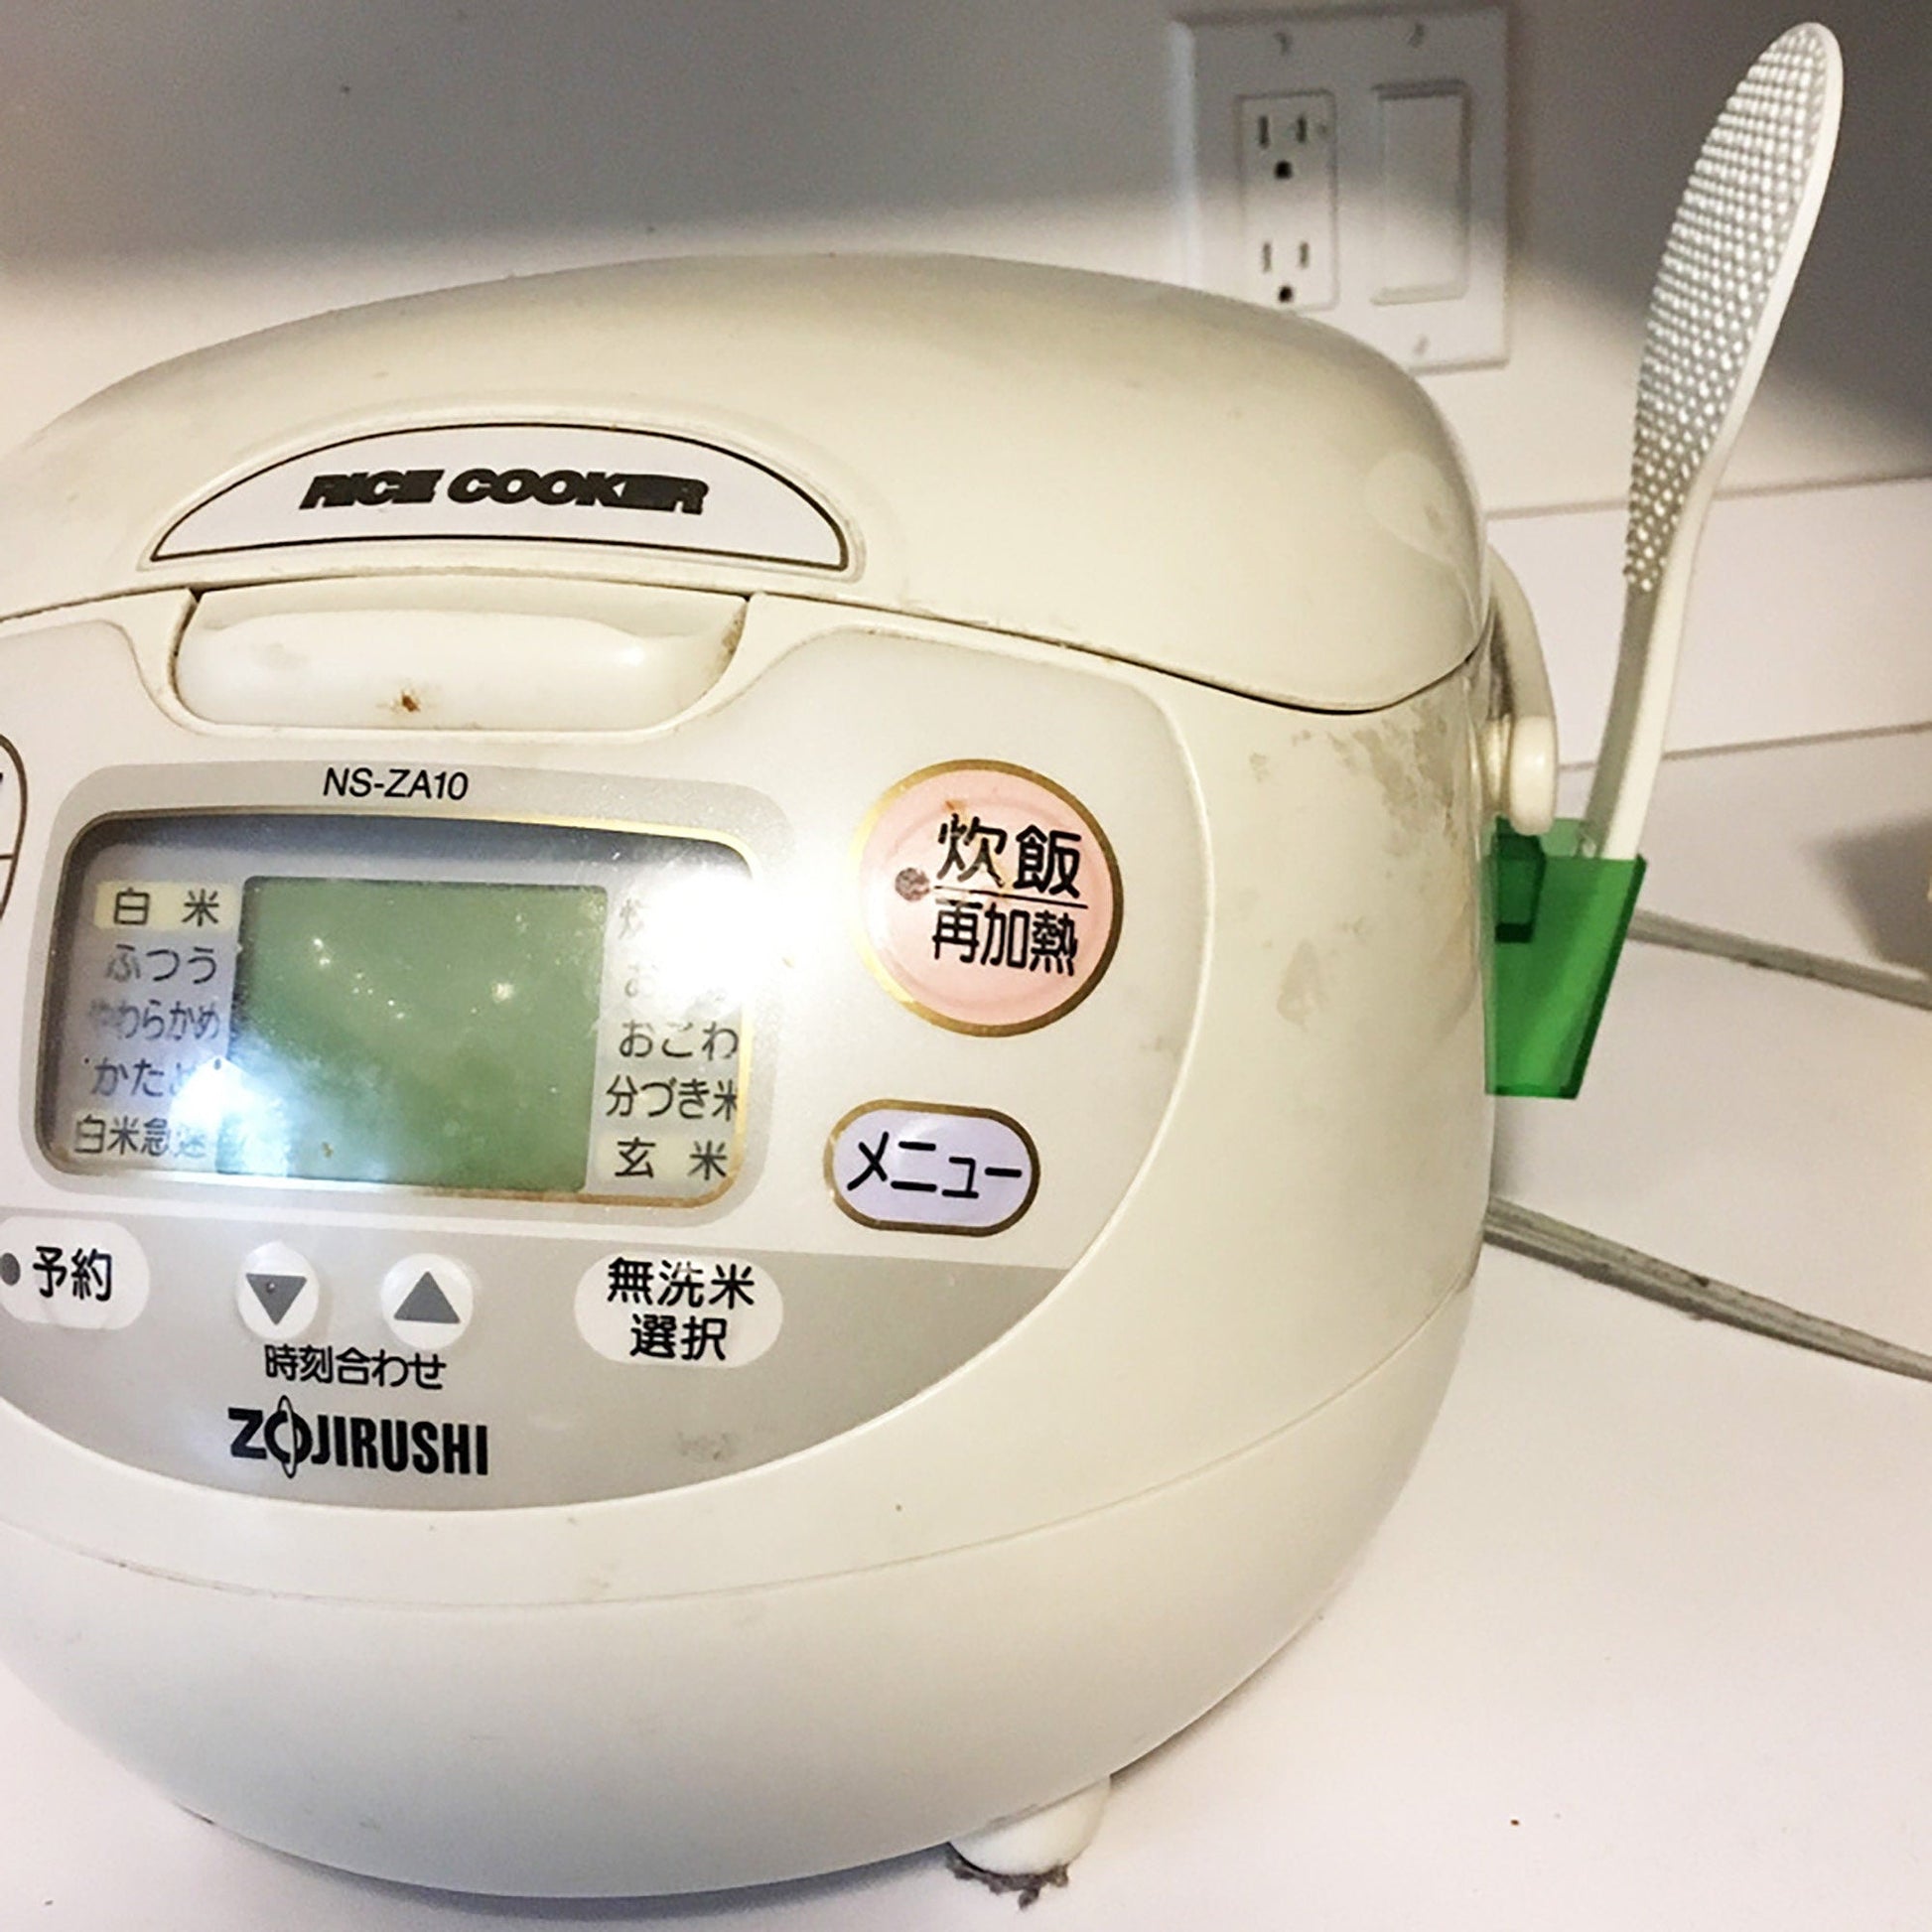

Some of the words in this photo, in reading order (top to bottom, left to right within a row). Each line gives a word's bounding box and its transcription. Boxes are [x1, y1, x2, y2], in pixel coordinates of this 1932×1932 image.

[299, 470, 445, 509] RICE
[448, 469, 709, 514] COOKER
[323, 766, 469, 800] NS-ZA10
[937, 813, 1082, 898] 炊飯
[932, 897, 1078, 977] 再加熱
[105, 944, 216, 984] ふつう
[607, 1074, 739, 1122] 分づき米
[848, 1131, 1023, 1199] メニュー
[33, 1246, 111, 1302] 予約
[608, 1257, 755, 1310] 無洗米
[630, 1313, 728, 1360] 選択
[264, 1343, 447, 1390] 時刻合わせ
[228, 1395, 487, 1478] ZOJIRUSHI
